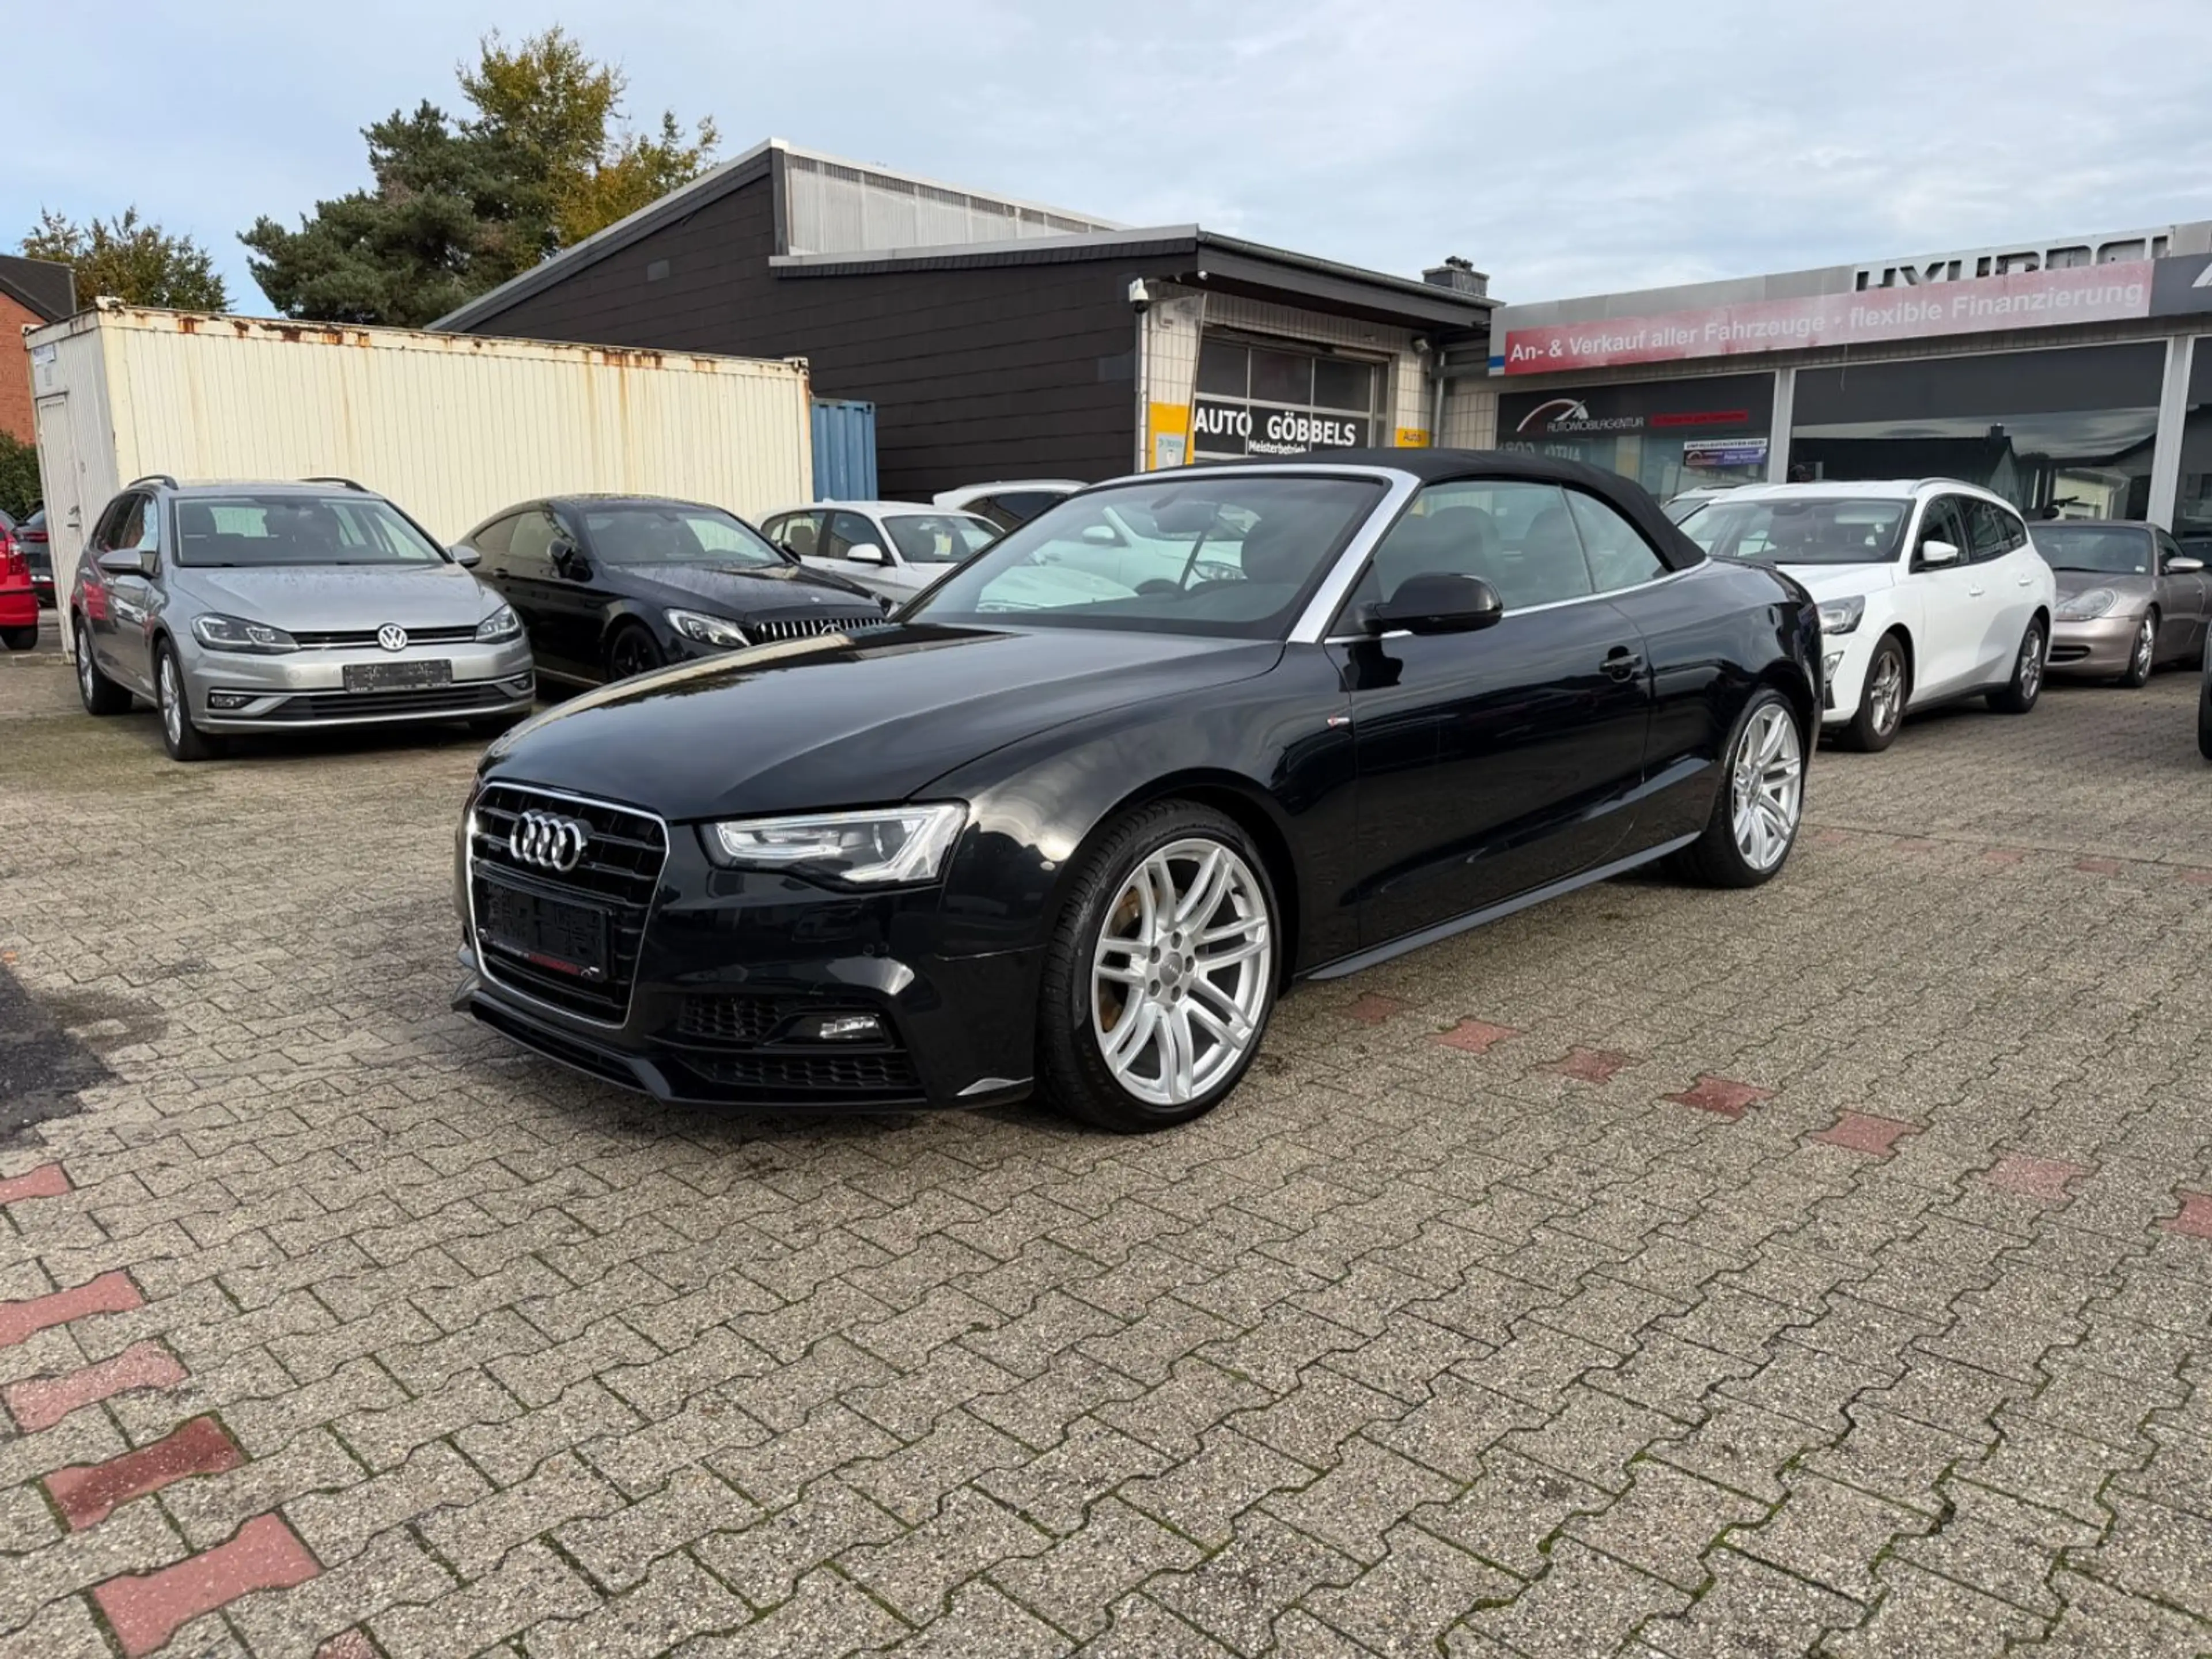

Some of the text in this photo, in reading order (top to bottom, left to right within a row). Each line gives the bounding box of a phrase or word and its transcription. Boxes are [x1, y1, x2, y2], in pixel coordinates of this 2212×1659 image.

[1509, 282, 2144, 362] An- & Verkauf aller Fahrzeuge flexible Finanzierung
[1194, 407, 1356, 447] AUTO GÖBBELS
